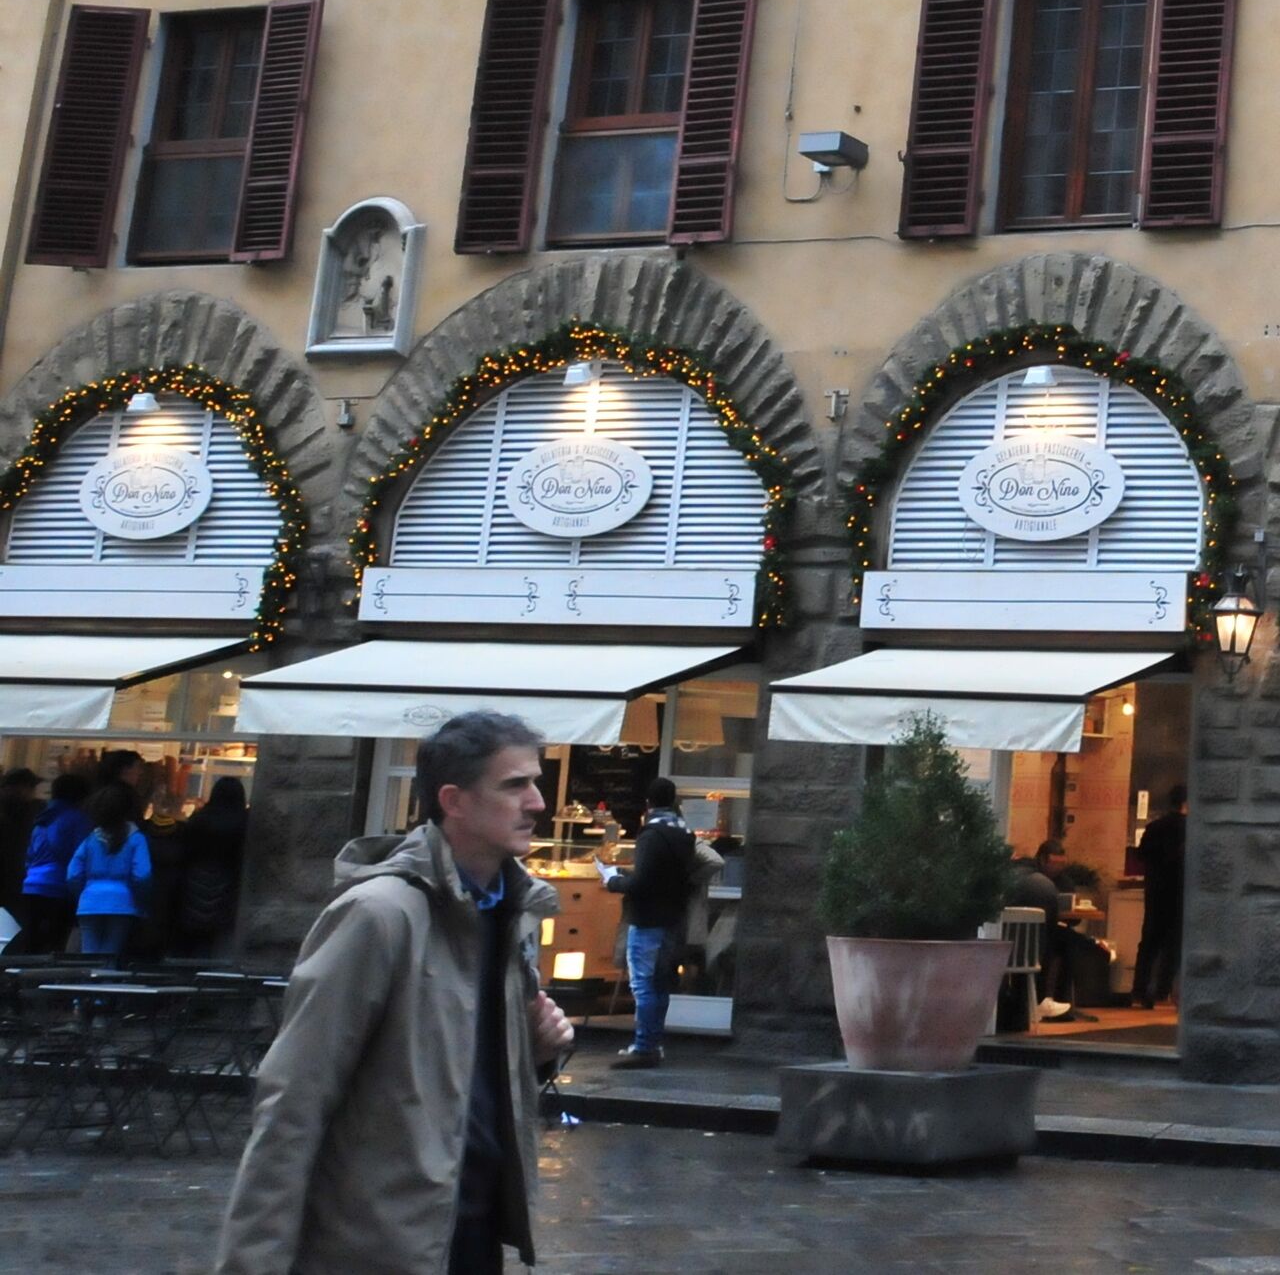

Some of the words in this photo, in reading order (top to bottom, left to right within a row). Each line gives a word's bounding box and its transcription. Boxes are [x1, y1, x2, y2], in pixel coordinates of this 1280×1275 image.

[111, 482, 140, 504] Don
[141, 482, 177, 504] Nino
[540, 477, 572, 500] Don
[574, 477, 612, 499] Nino
[999, 477, 1034, 502] Don
[1037, 477, 1080, 501] Nino
